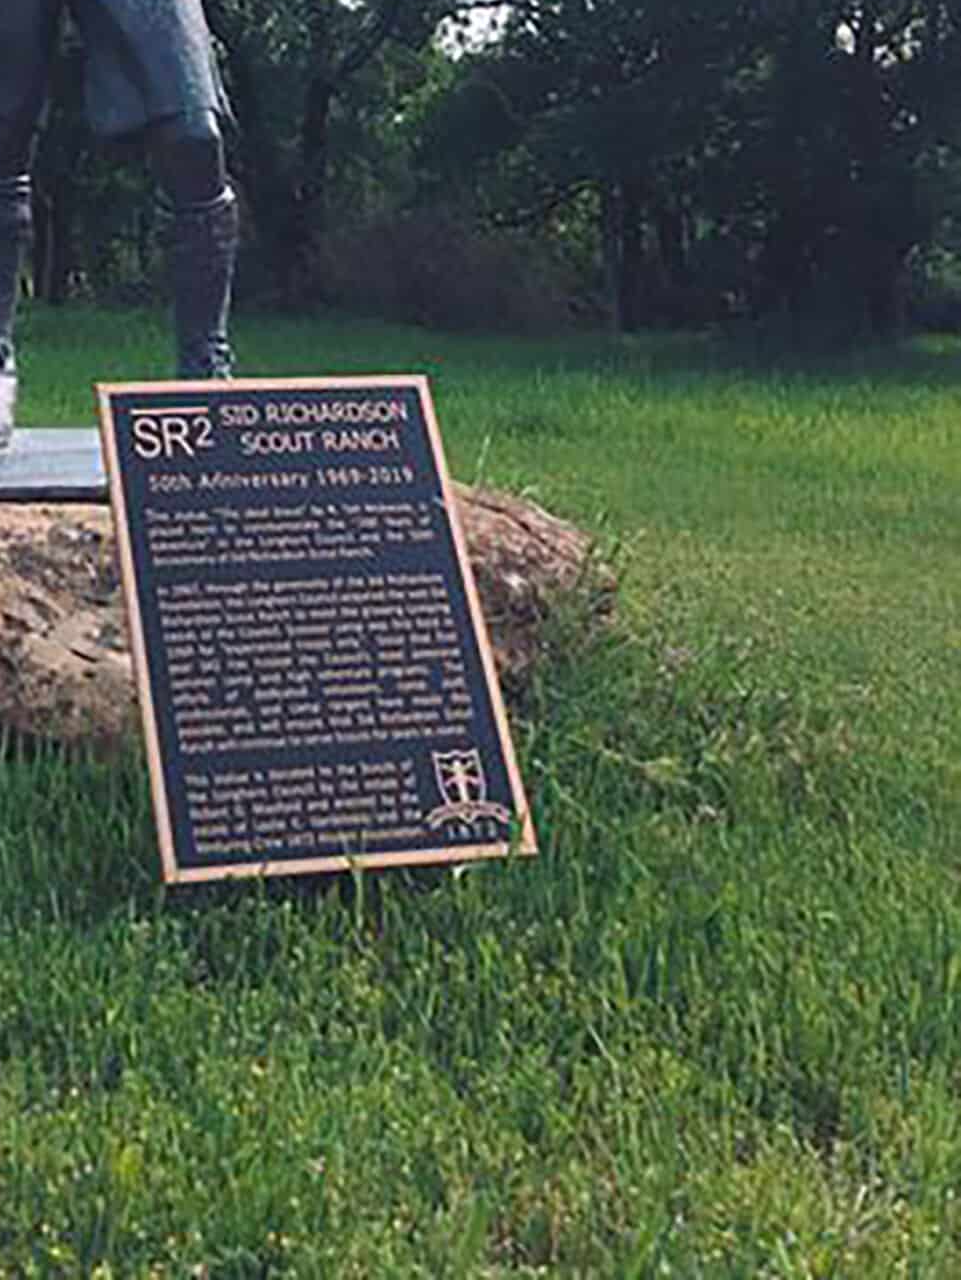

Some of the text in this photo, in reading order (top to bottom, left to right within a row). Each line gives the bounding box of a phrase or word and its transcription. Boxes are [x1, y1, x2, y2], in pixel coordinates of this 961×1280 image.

[220, 400, 408, 426] SID RICHARDSON
[241, 427, 401, 456] SCOUT RANCH
[199, 470, 308, 492] Anniversary
